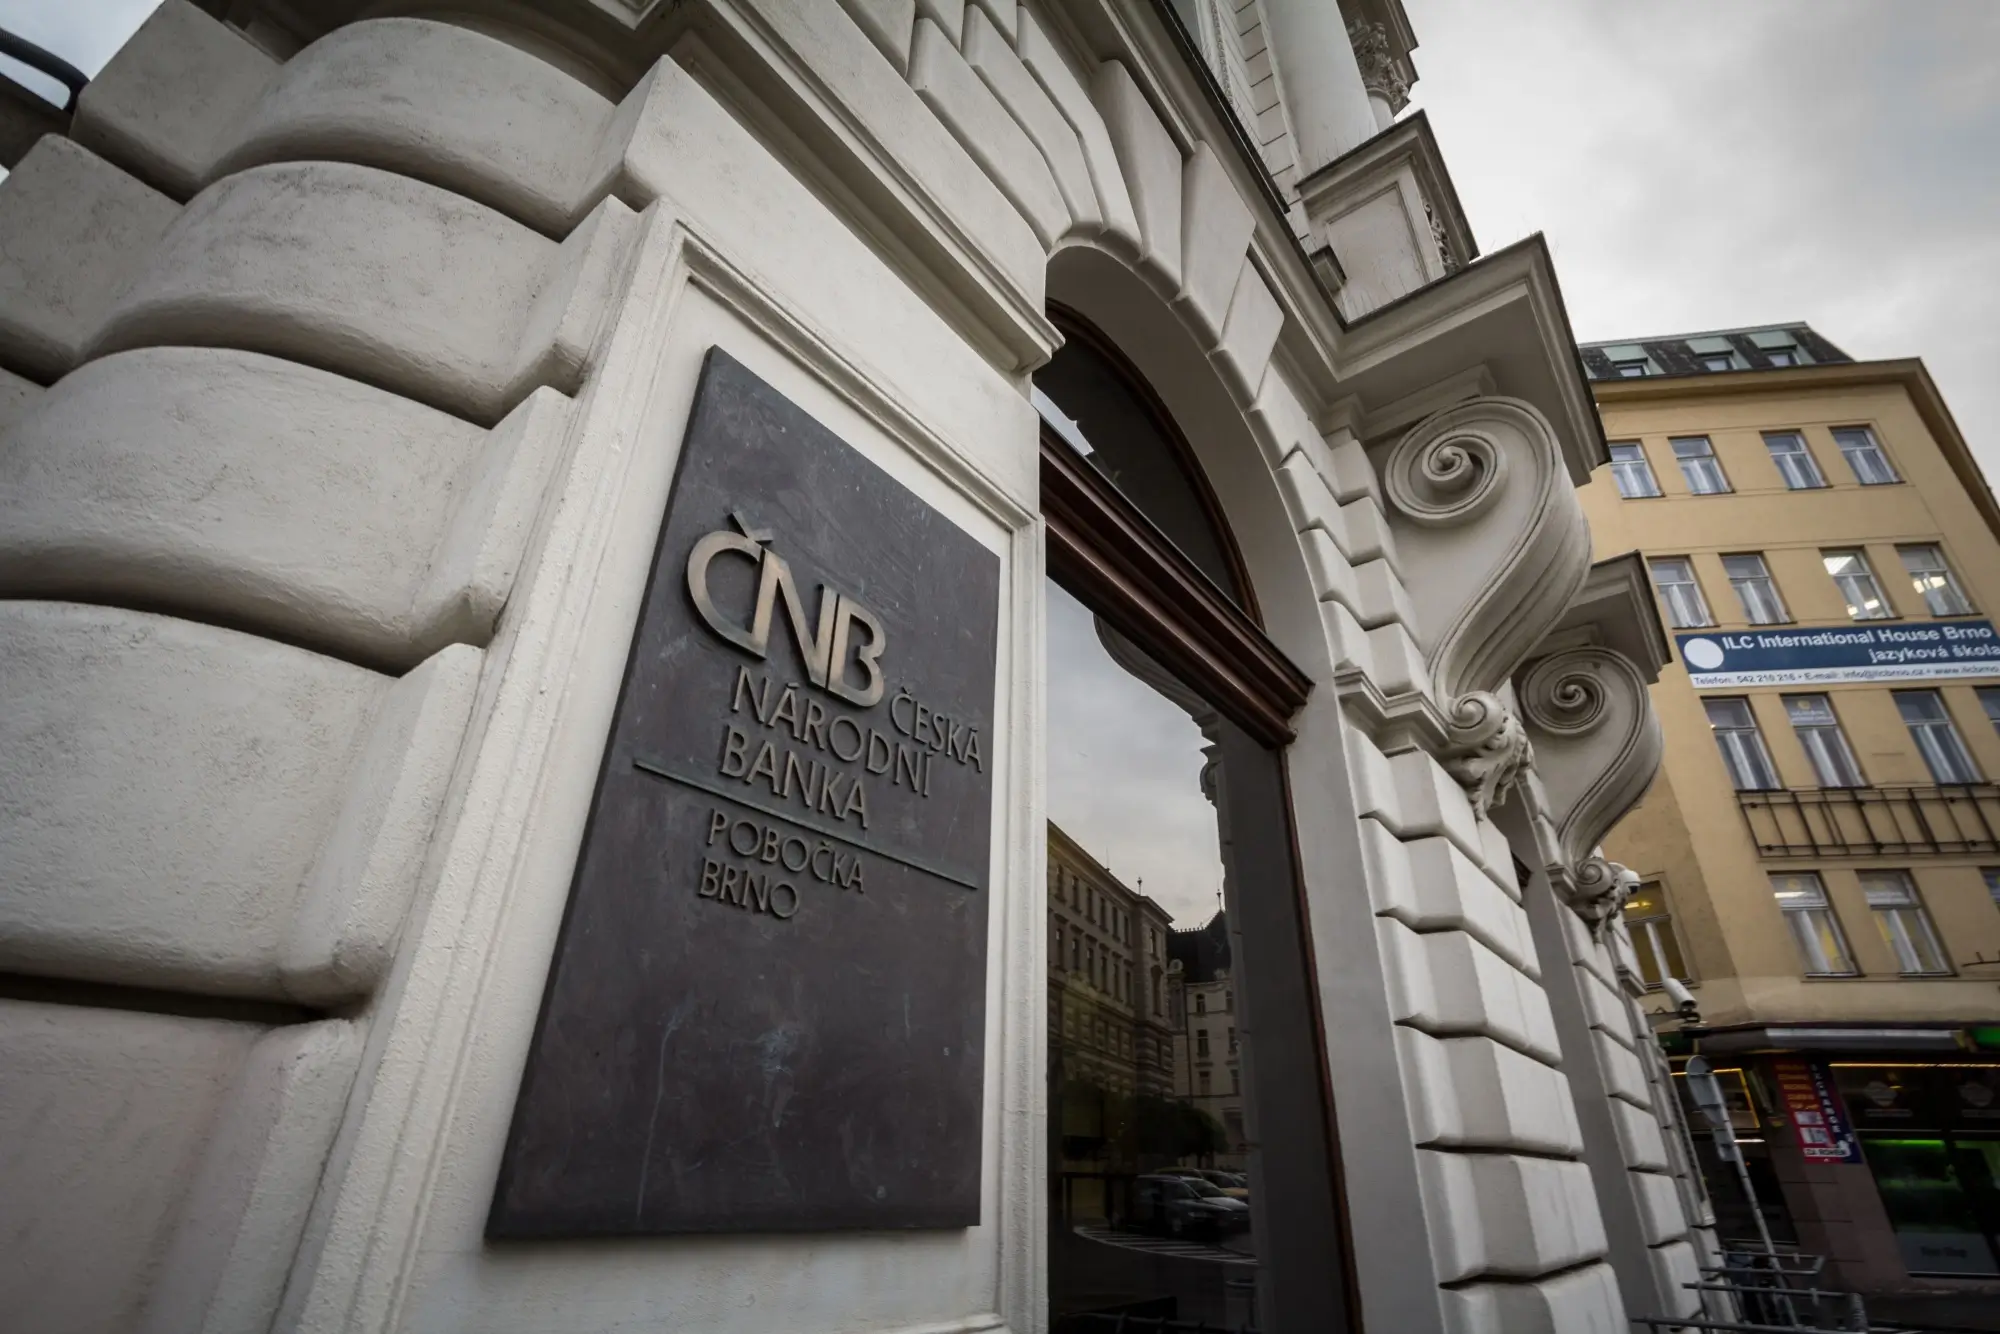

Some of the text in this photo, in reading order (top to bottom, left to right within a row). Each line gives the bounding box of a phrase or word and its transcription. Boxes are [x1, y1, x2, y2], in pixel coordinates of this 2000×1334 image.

[687, 510, 887, 708] ČNB
[1721, 625, 1993, 650] ILC International House Brno
[1869, 643, 2000, 664] jazyková škola
[731, 664, 935, 798] NÁRODNÍ
[890, 686, 983, 773] ČESKÁ
[719, 723, 870, 830] BANKA
[697, 857, 801, 919] BRNO
[706, 807, 865, 894] POBOČKA
